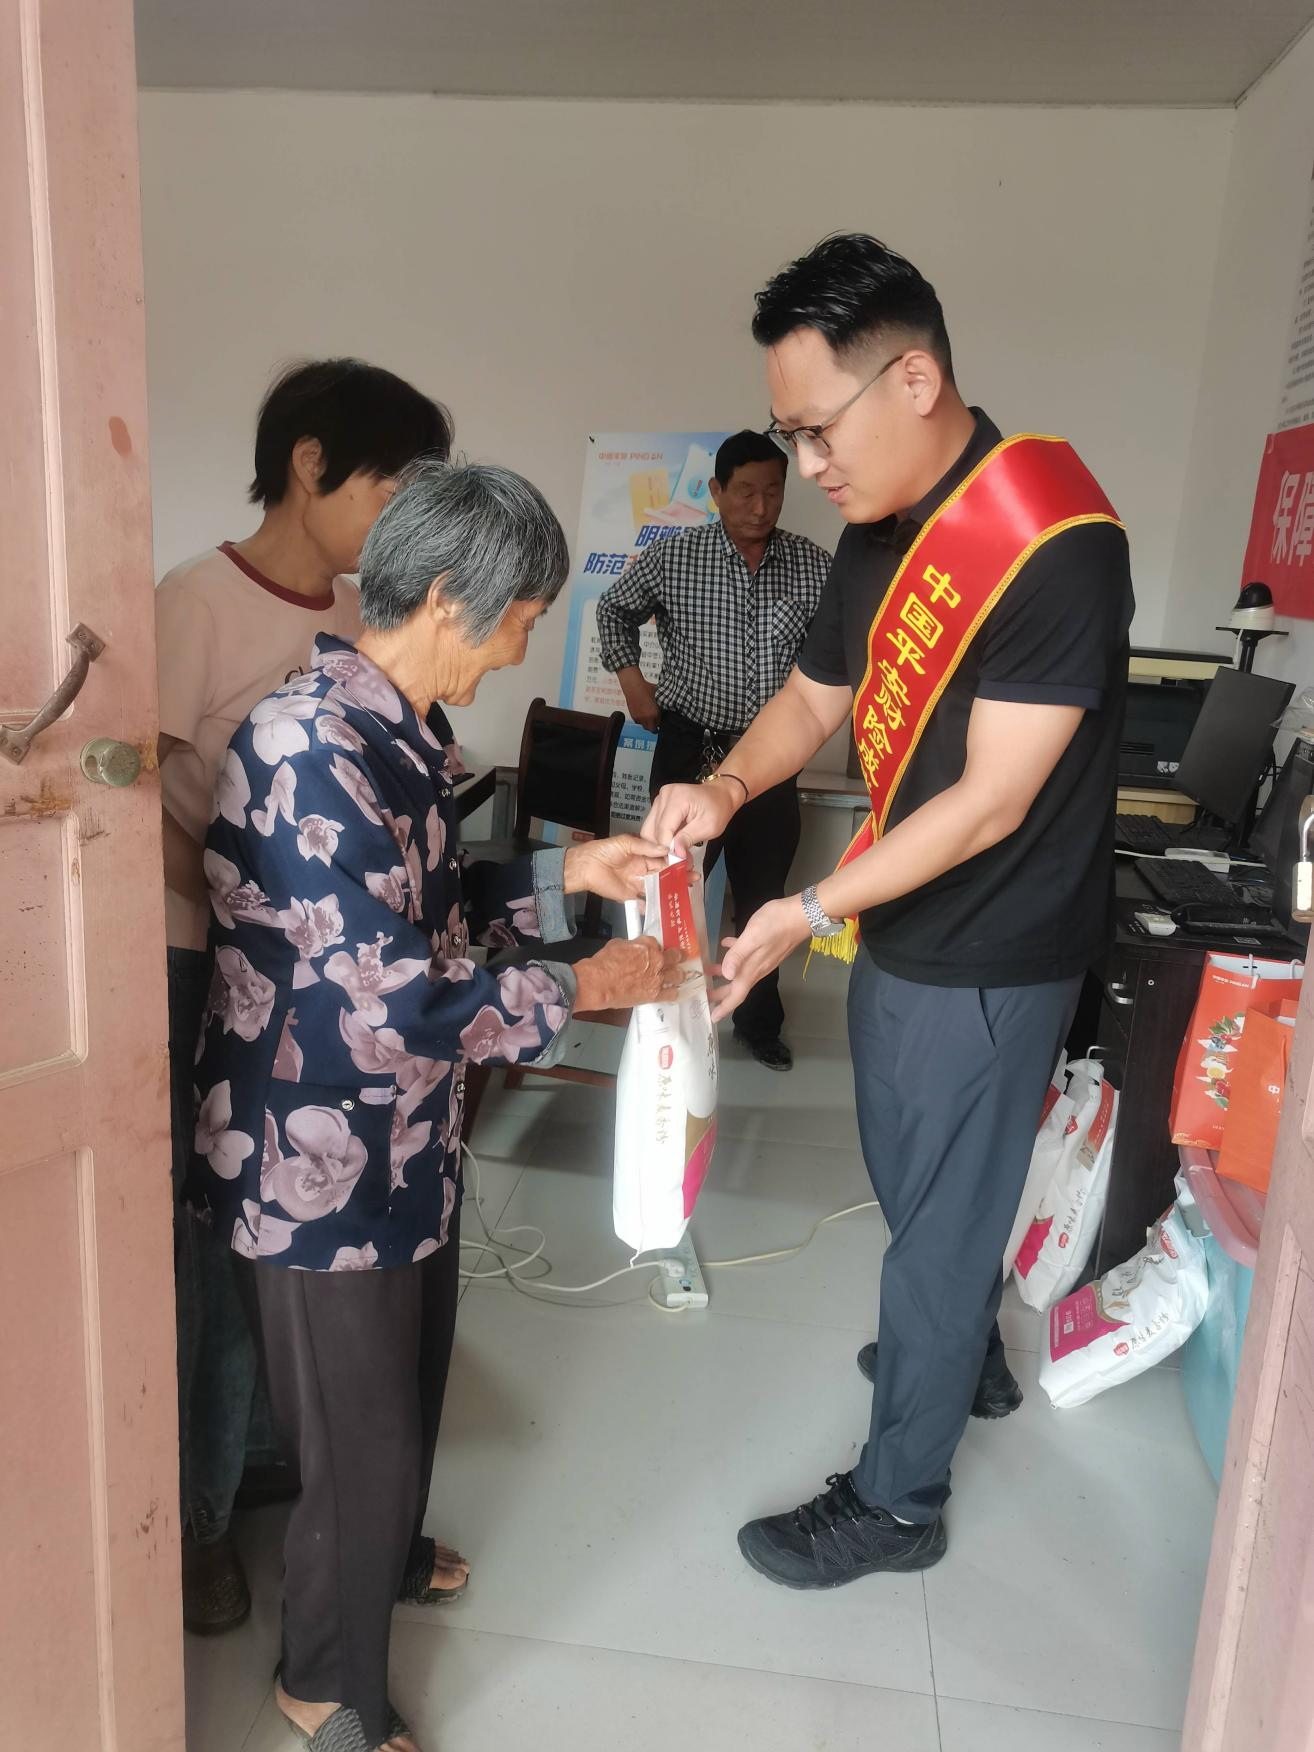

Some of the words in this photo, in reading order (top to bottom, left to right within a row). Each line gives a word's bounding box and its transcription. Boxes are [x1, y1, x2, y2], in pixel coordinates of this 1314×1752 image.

[858, 564, 962, 794] 中国平安财险成
